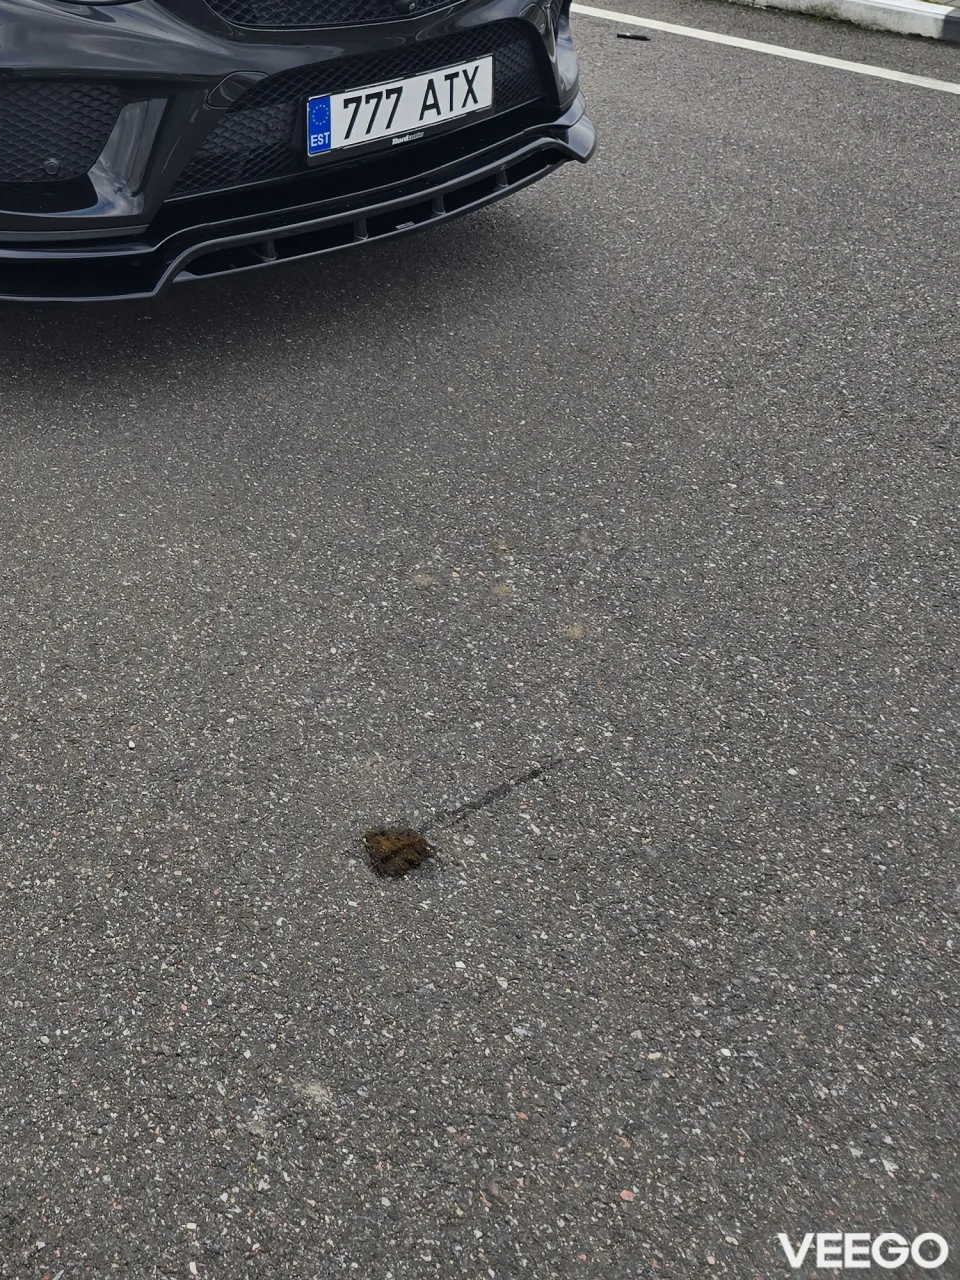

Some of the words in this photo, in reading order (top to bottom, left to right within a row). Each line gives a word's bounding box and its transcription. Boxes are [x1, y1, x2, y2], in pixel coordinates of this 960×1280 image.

[343, 86, 403, 139] 777
[419, 65, 479, 121] ATX
[310, 131, 330, 147] EST
